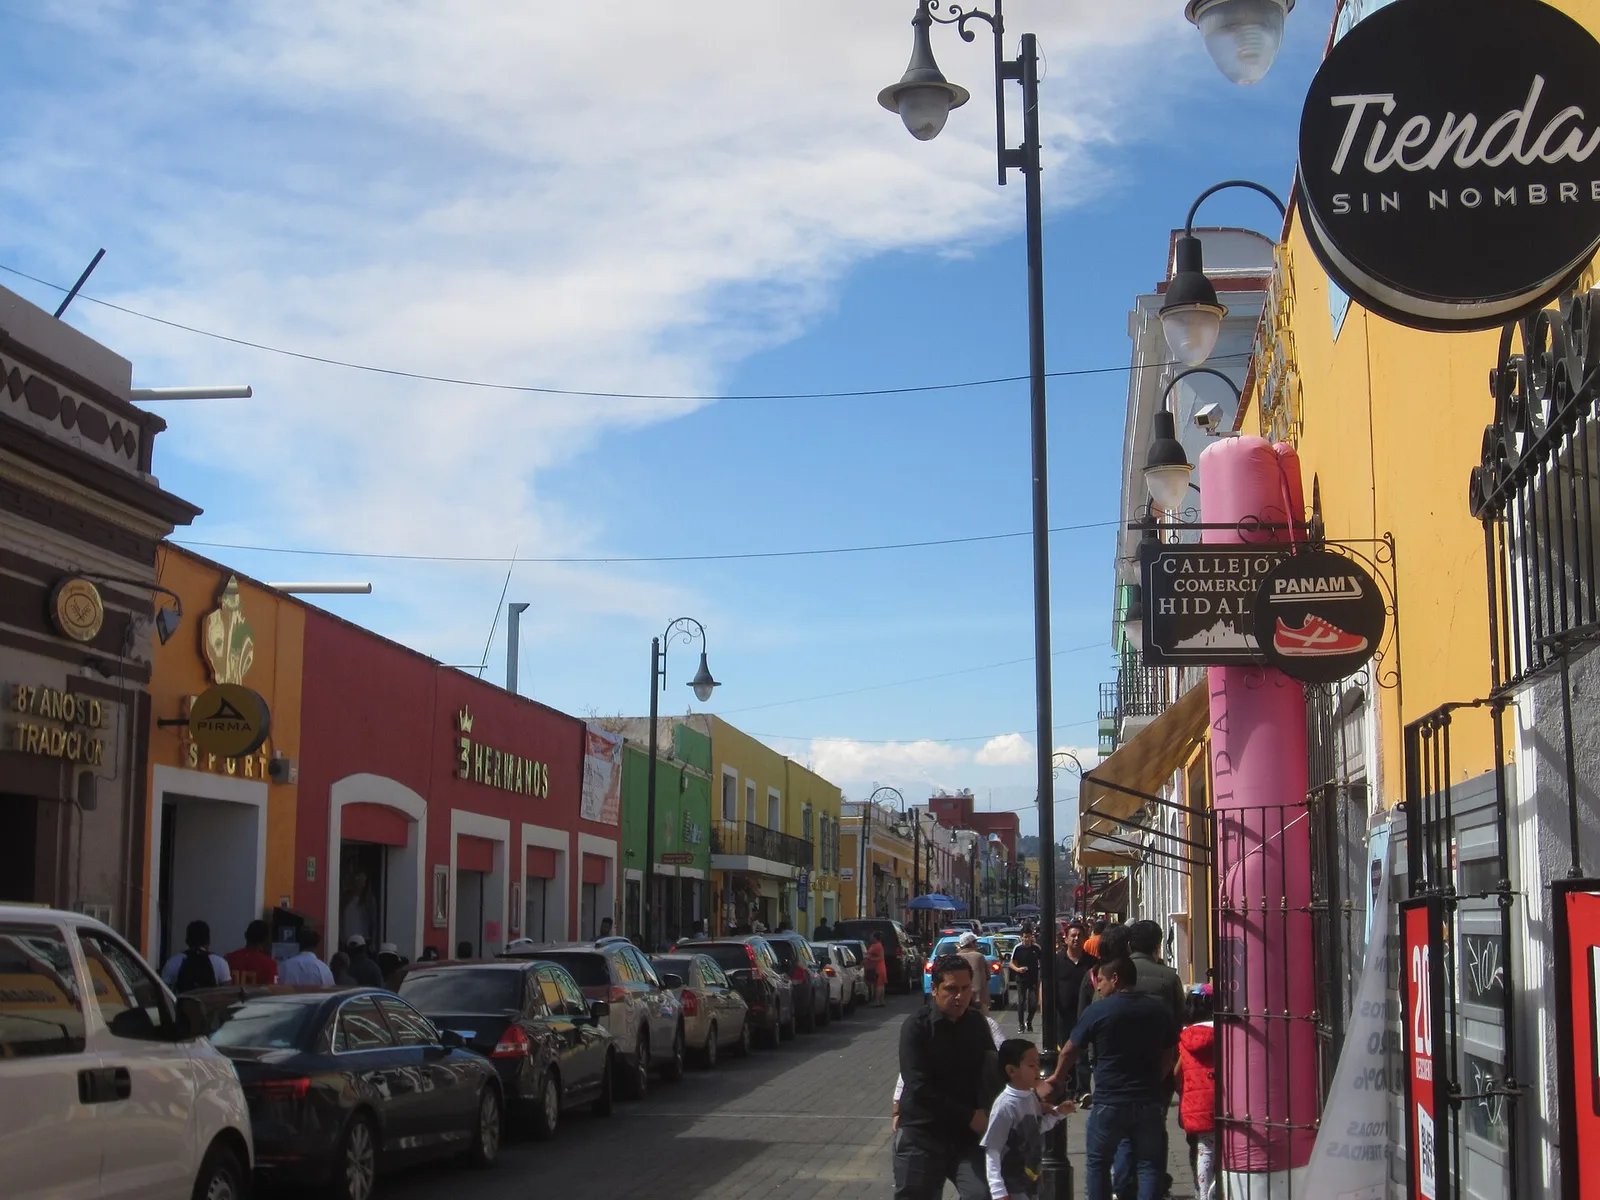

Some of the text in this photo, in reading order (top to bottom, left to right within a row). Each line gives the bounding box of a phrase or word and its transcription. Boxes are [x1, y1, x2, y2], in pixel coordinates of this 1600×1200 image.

[1331, 74, 1600, 175] Tienda
[1332, 180, 1600, 215] SIN NOMBRE
[1173, 579, 1265, 592] COMERCI
[1275, 576, 1345, 594] PANAM
[18, 685, 36, 713] 87
[197, 721, 252, 732] PIRMA
[460, 736, 471, 779] 3
[474, 743, 548, 799] HERMANOS
